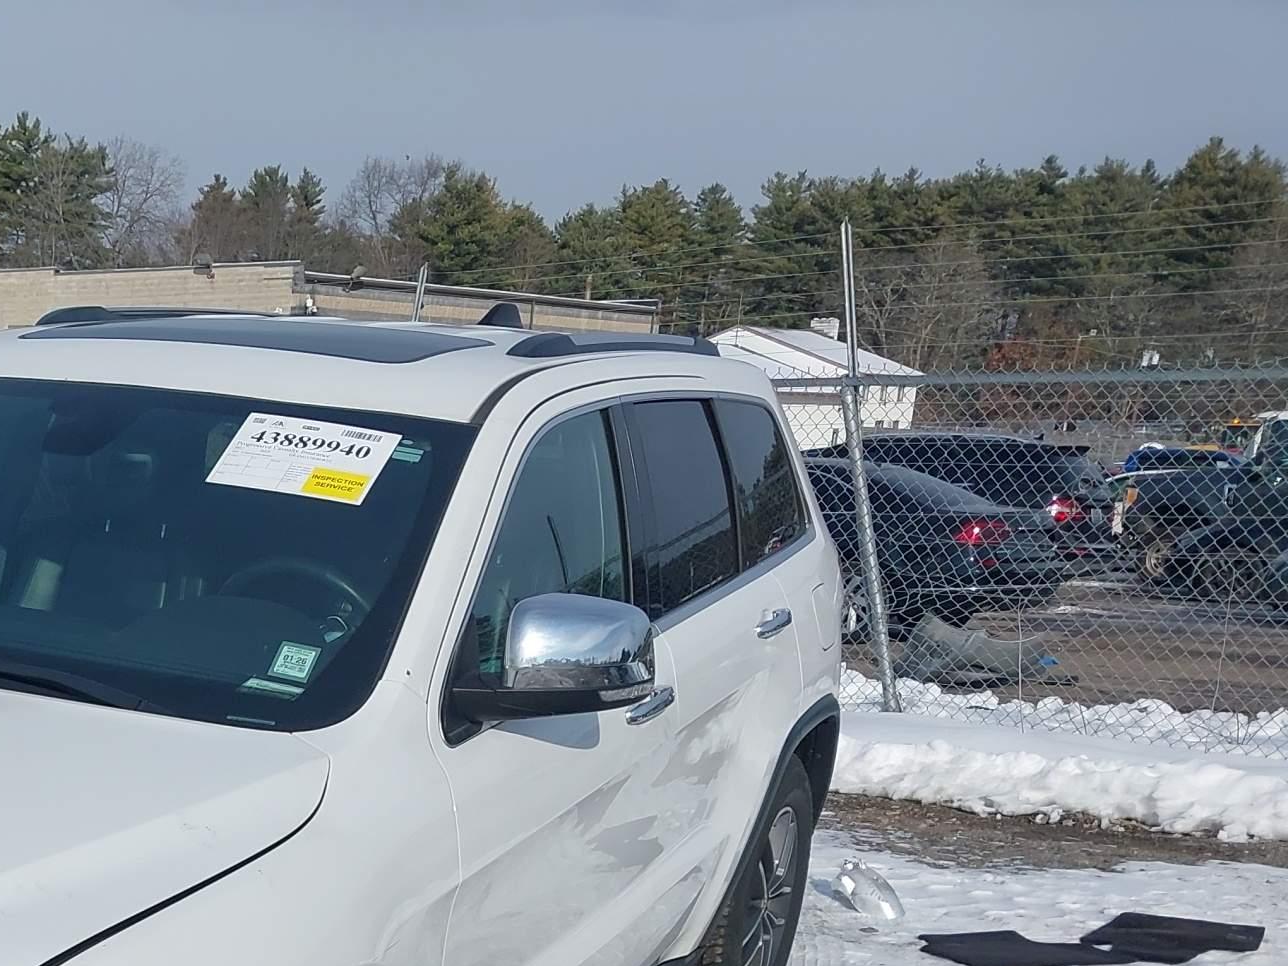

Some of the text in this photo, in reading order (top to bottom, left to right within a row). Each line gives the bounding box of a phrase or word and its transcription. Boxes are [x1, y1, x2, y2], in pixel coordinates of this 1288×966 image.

[250, 429, 372, 460] 43889940
[311, 474, 365, 488] INSPECTION
[313, 481, 355, 493] SERVICE
